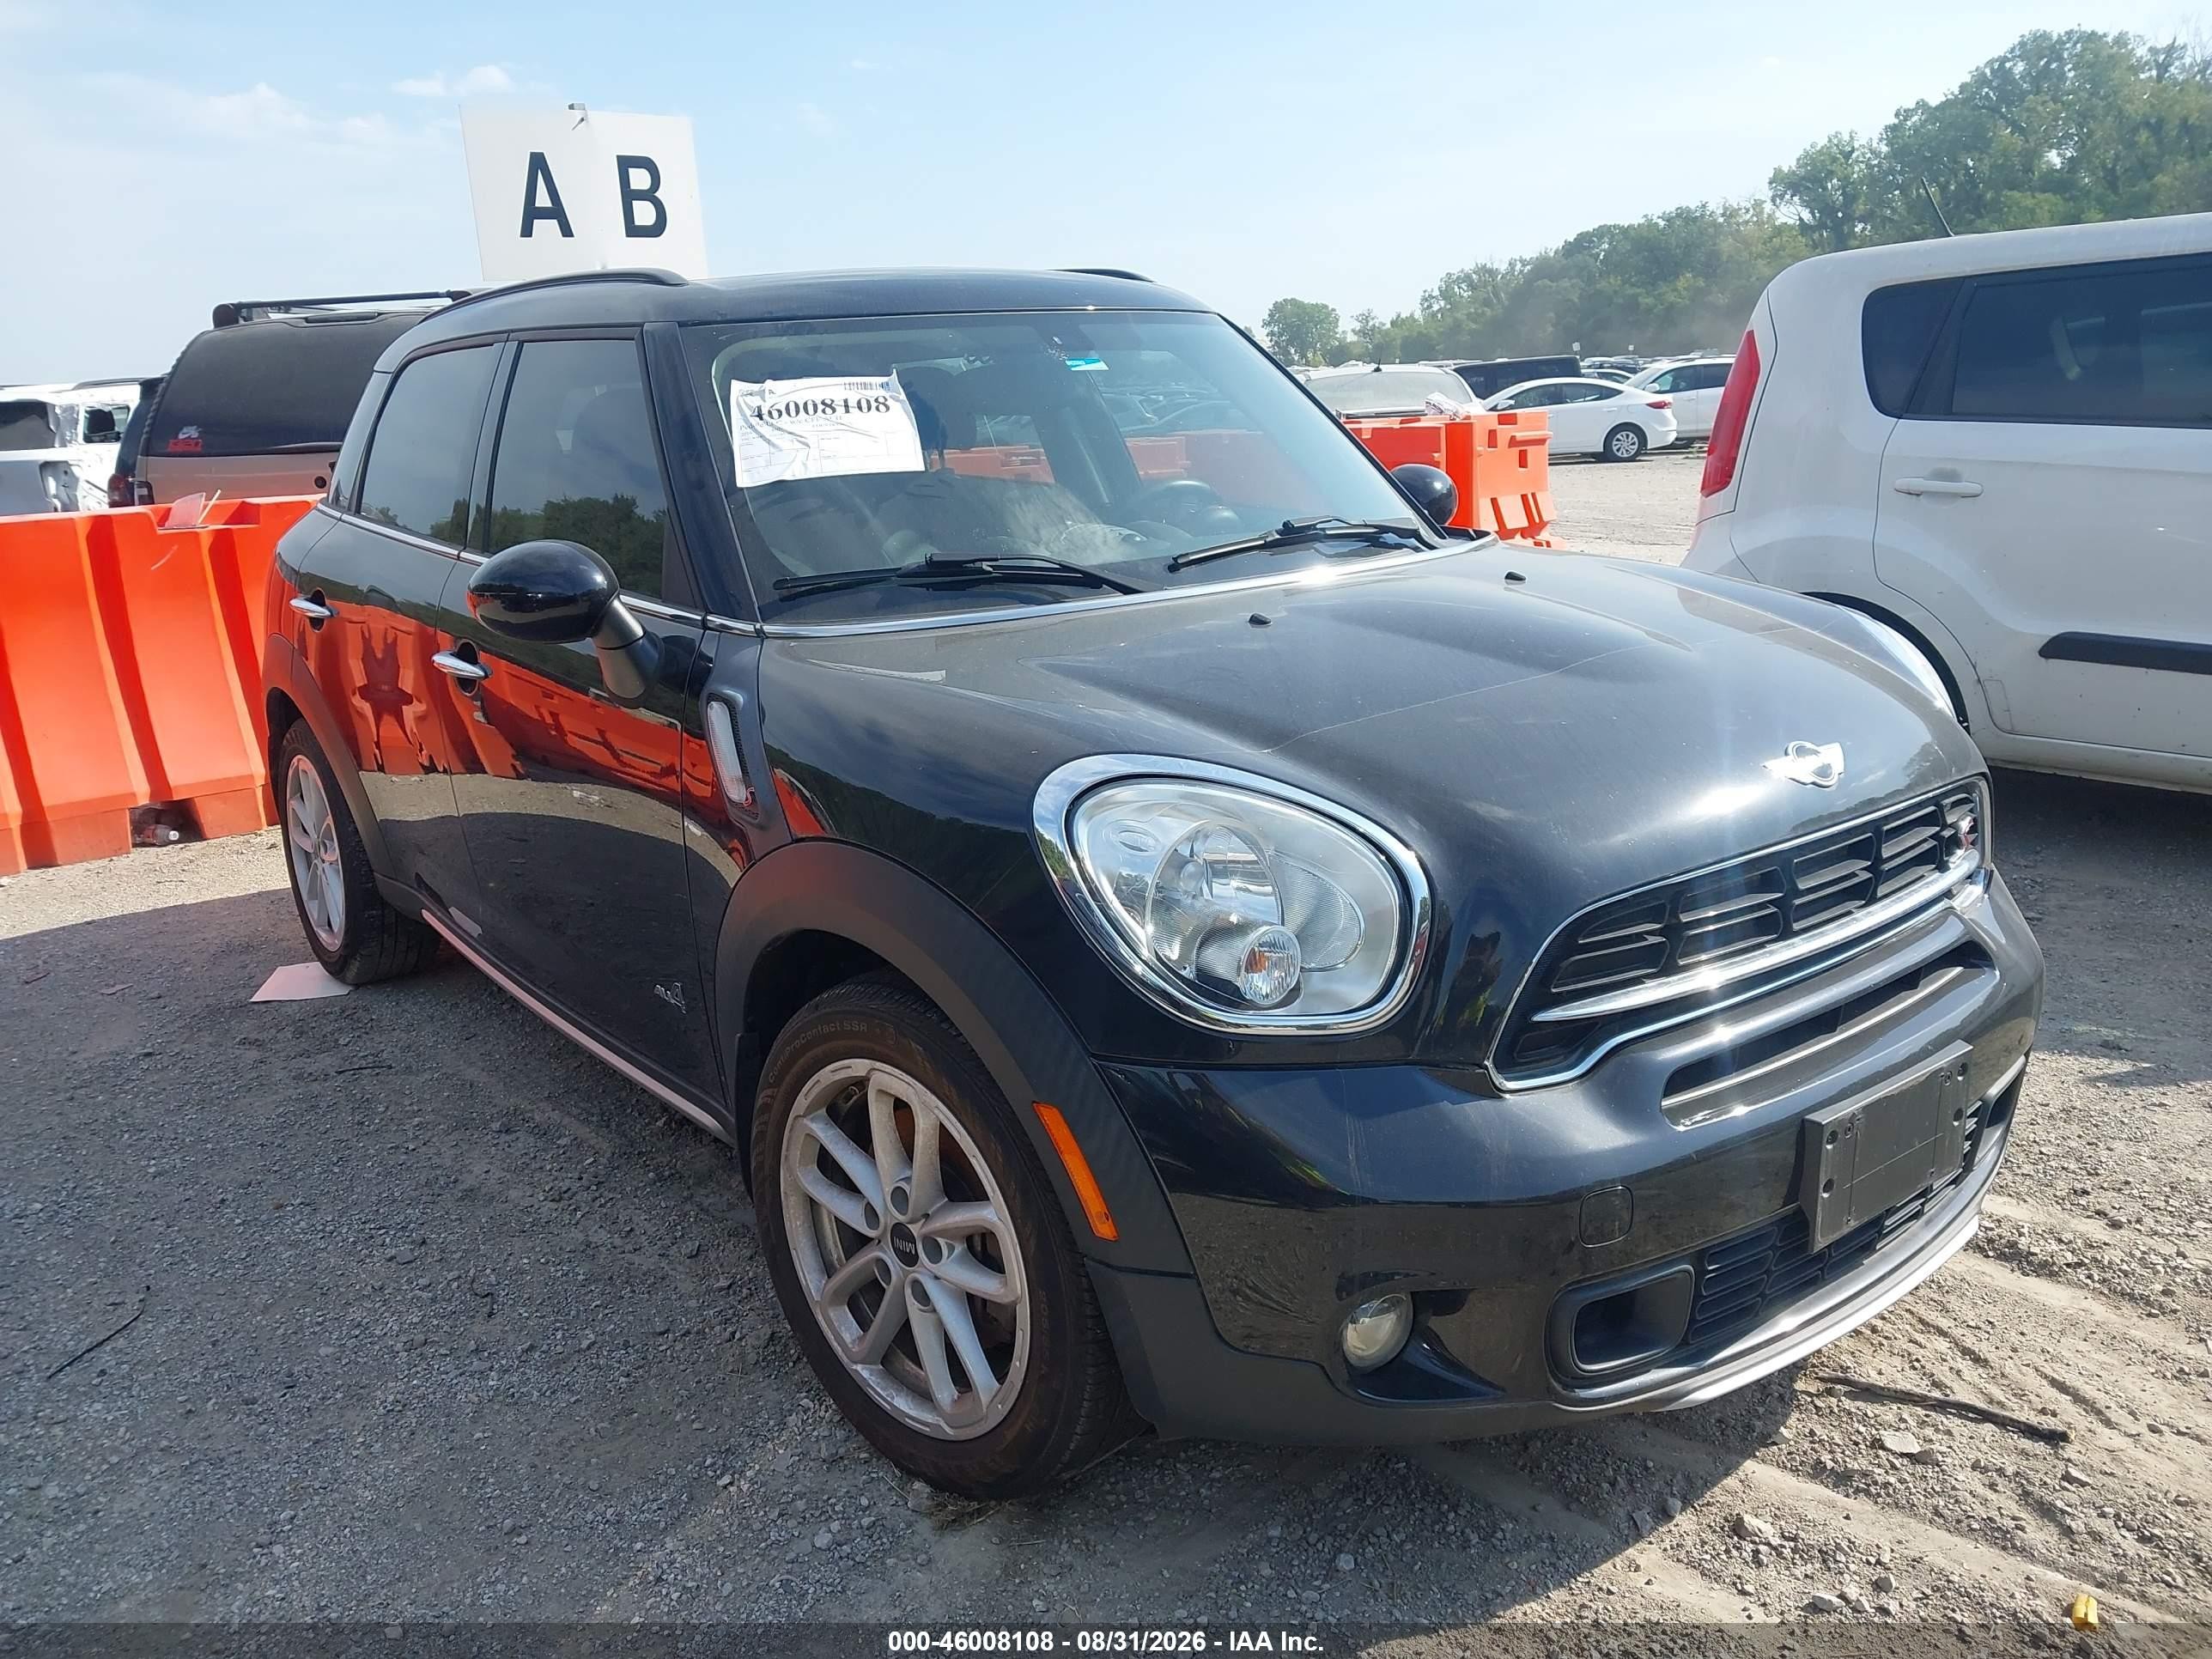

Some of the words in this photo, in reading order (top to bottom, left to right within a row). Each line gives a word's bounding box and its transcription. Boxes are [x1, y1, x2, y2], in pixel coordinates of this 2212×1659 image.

[520, 151, 575, 239] A
[616, 155, 668, 239] B
[750, 395, 890, 421] 46008108
[893, 1236, 915, 1255] MINI
